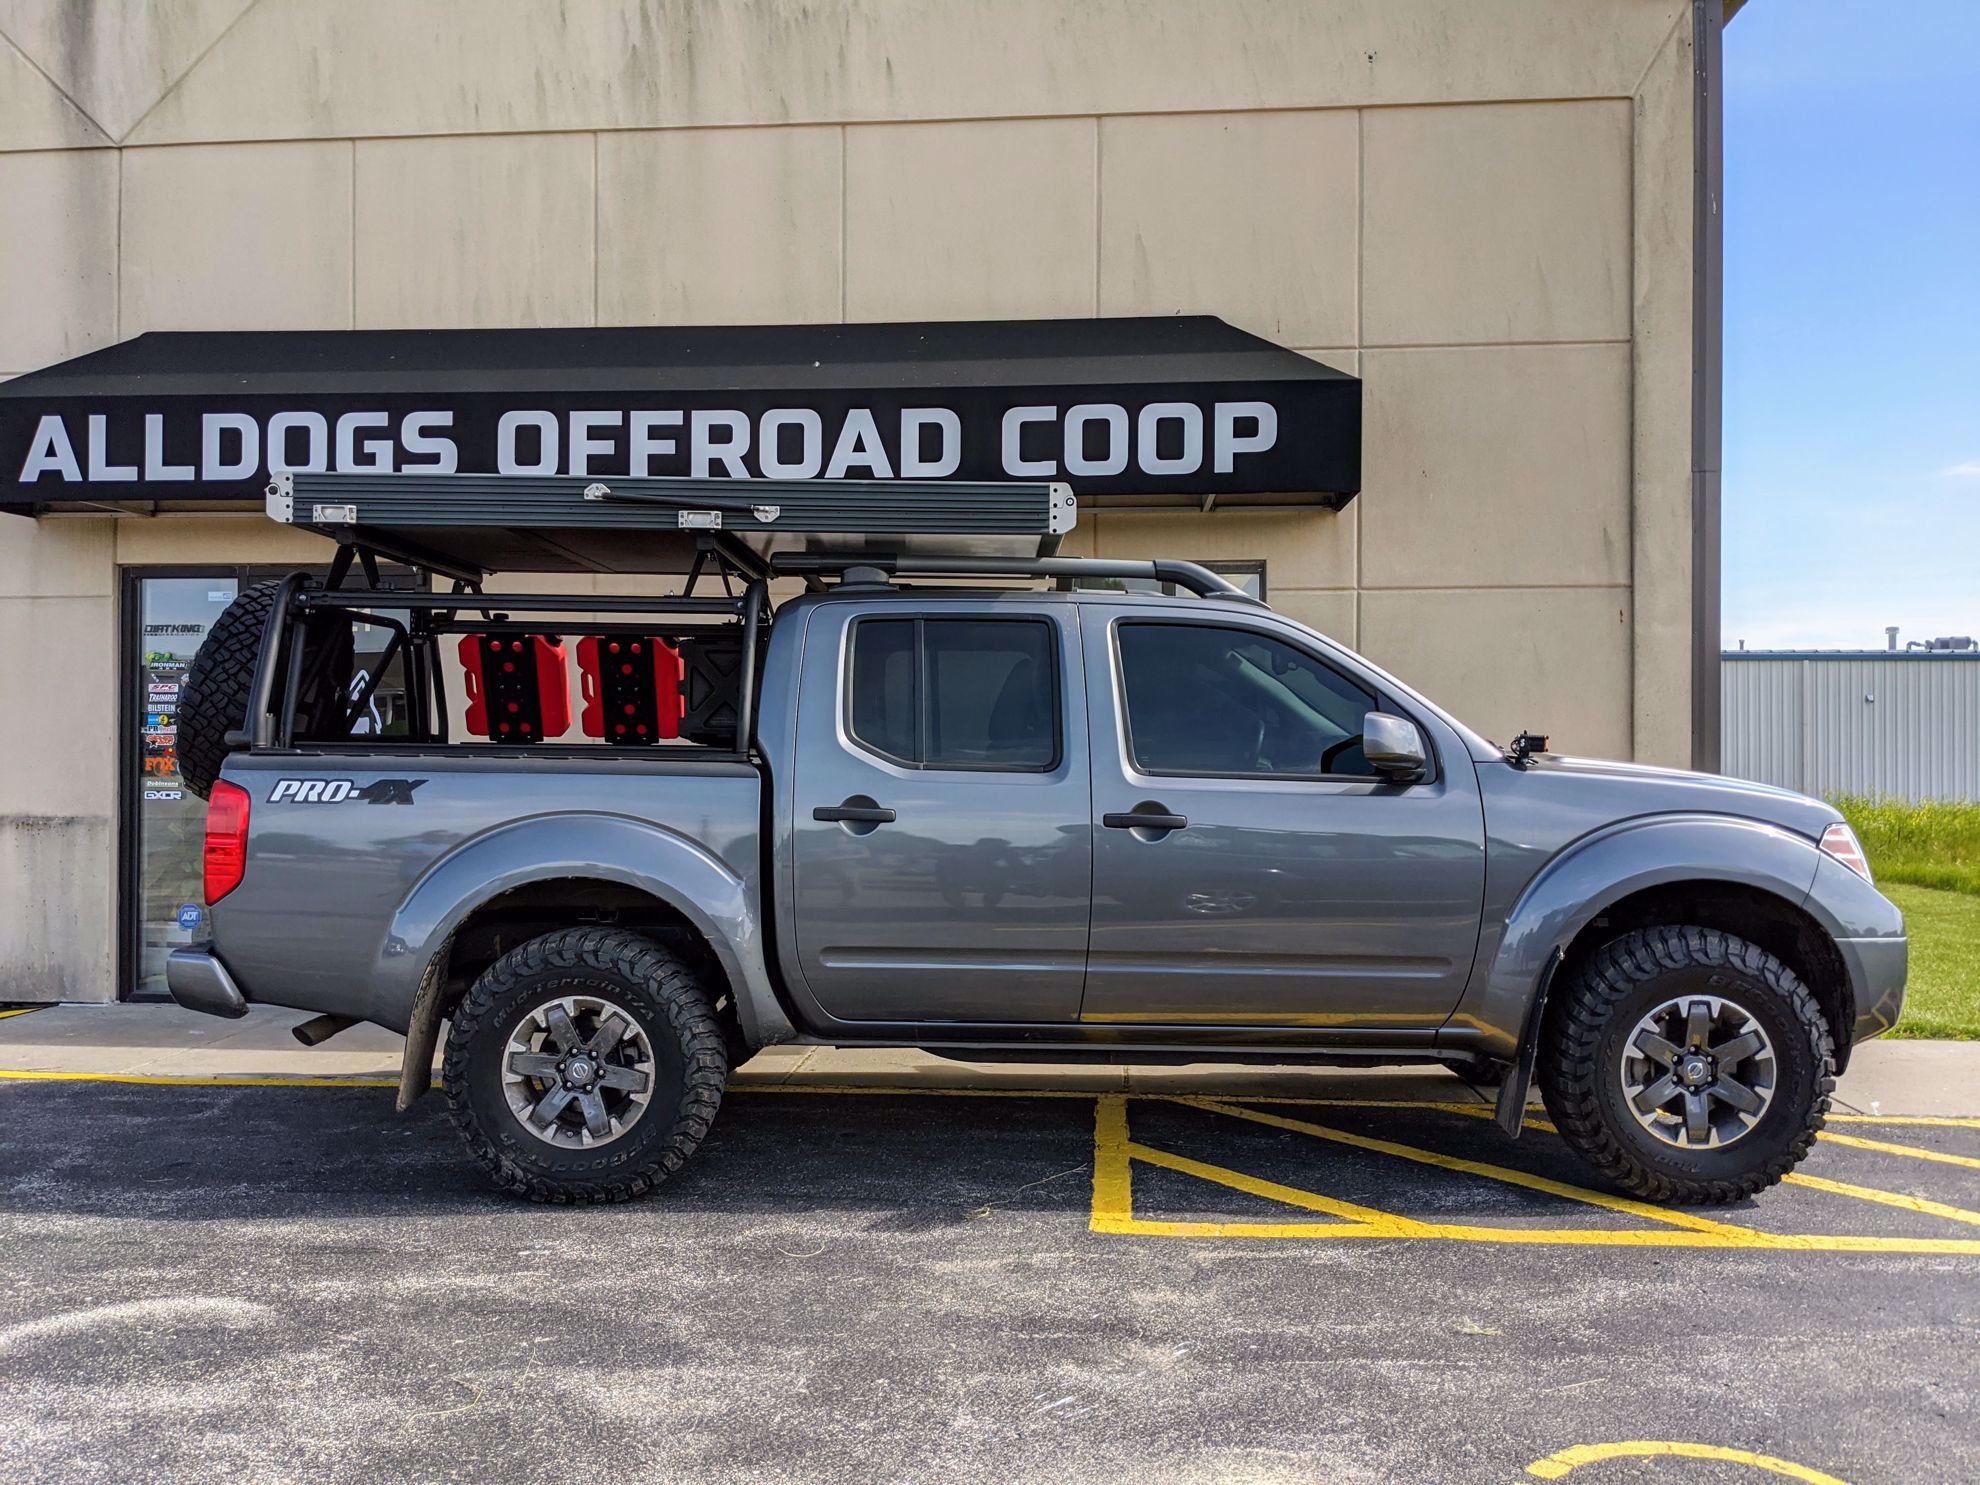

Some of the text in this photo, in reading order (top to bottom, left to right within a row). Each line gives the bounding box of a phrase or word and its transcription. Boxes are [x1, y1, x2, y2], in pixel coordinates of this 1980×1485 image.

[18, 400, 1278, 482] ALLDOGS OFFROAD COOP
[145, 757, 176, 771] FOX
[181, 911, 198, 920] ADT
